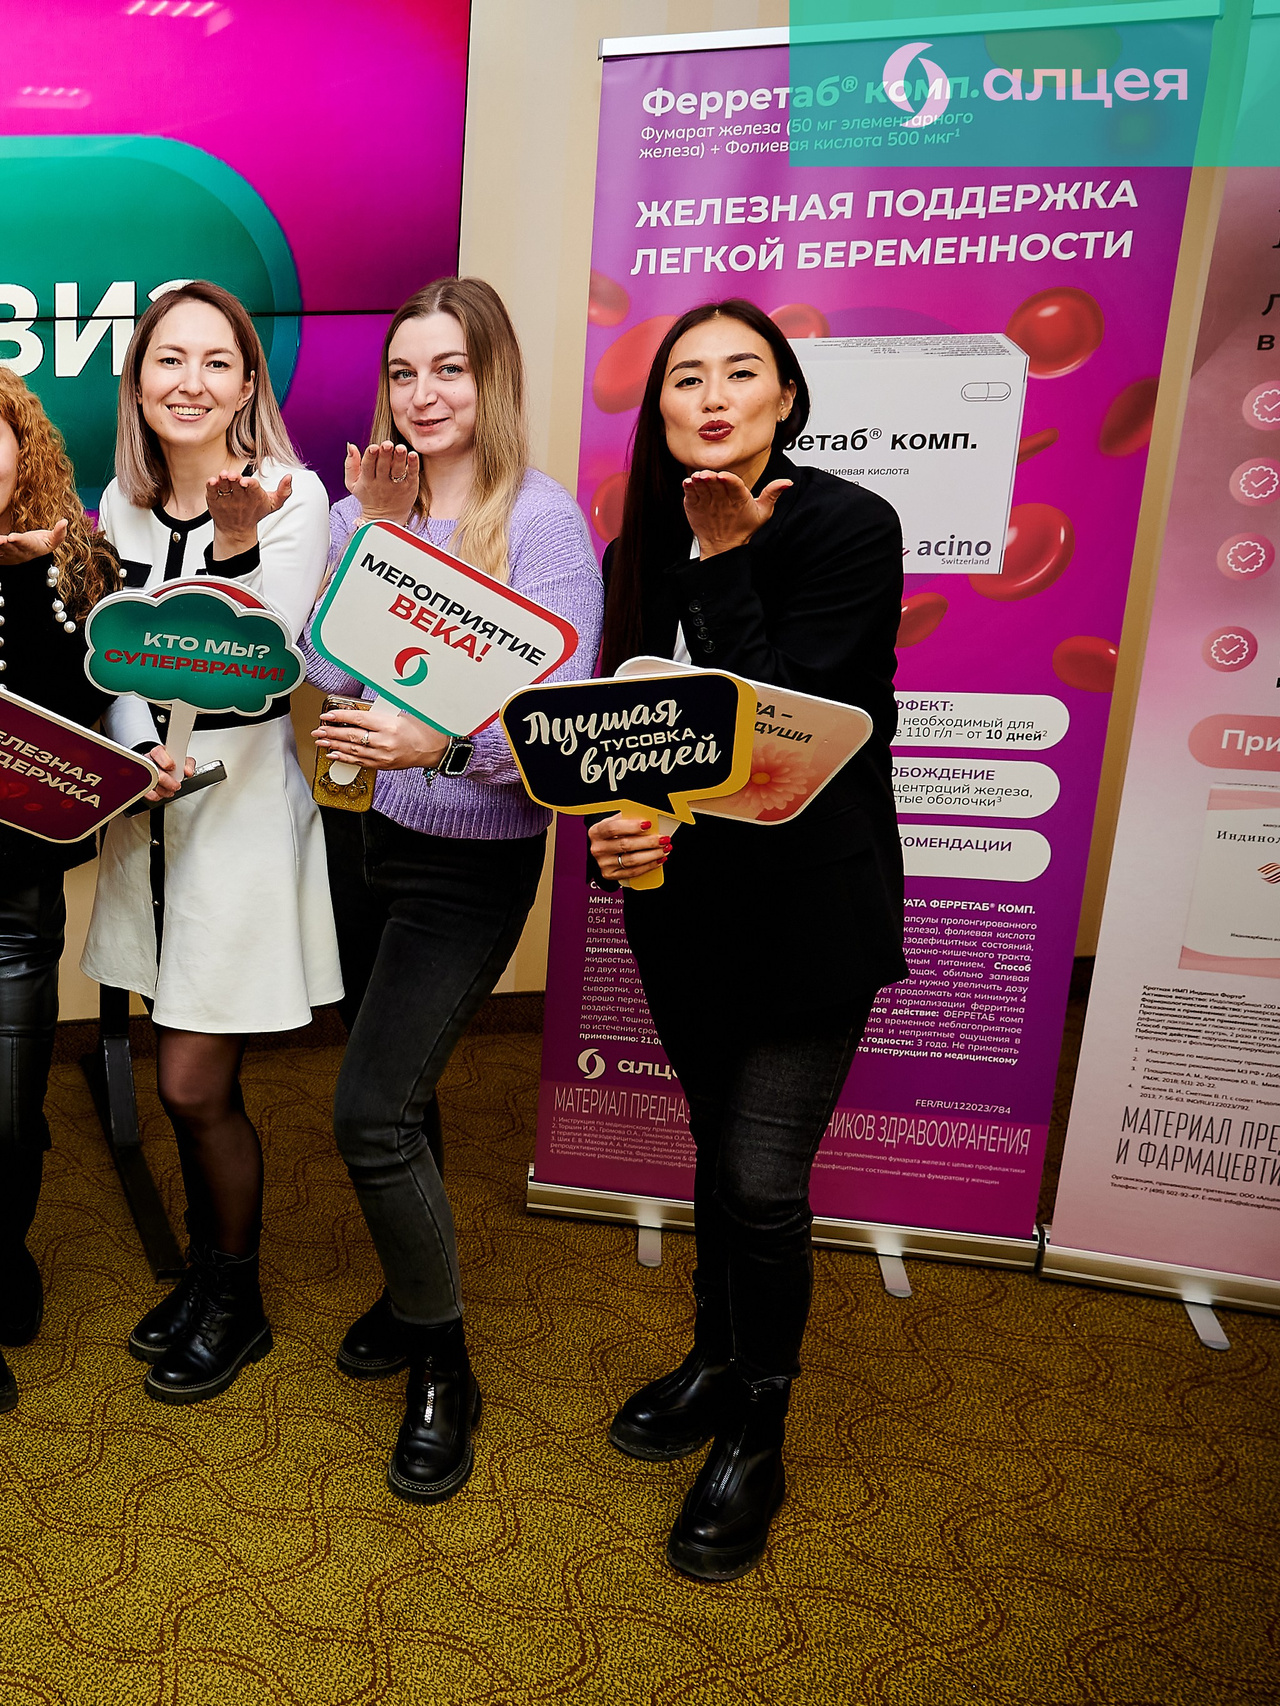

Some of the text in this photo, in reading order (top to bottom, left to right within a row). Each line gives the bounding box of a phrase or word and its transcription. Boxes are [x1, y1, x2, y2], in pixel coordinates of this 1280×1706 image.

[866, 75, 980, 104] комп.
[641, 112, 973, 141] Фумарат железа (50 мг элементарного
[638, 144, 705, 159] железа)
[711, 145, 719, 154] +
[725, 140, 809, 154] Фолиевая
[814, 136, 882, 150] кислота
[888, 132, 918, 146] 500
[636, 179, 1138, 227] ЖЕЛЕЗНАЯ ПОДДЕРЖКА
[630, 230, 1133, 276] ЛЕГКОЙ БЕРЕМЕННОСТИ
[891, 432, 977, 450] комп.
[868, 467, 909, 475] кислота
[917, 534, 992, 556] acino
[360, 553, 546, 666] МЕРОПРИЯТИЕ
[388, 594, 492, 663] ВЕКА!
[144, 632, 271, 659] КТО МЫ?
[104, 649, 286, 682] СУПЕРВРАЧИ!
[522, 699, 682, 755] Лучшая
[903, 715, 1034, 729] необходимый для
[600, 728, 696, 752] ТУСОВКА
[907, 727, 930, 737] 110
[934, 728, 952, 738] г/л
[967, 731, 982, 739] от
[986, 730, 1002, 739] 10
[1221, 729, 1280, 756] При
[580, 734, 721, 791] врачей
[892, 767, 995, 780] ОБОЖДЕНИЕ
[893, 783, 1033, 798] центраций железа,
[900, 837, 1012, 852] ОМЕНДАЦИИ
[589, 896, 613, 904] МНН:
[588, 907, 623, 915] действи
[998, 904, 1036, 914] КОМП.
[904, 916, 1037, 930] апсулы пролонгированного
[945, 928, 992, 938] фолиевая
[996, 932, 1036, 940] кислота
[597, 966, 617, 974] двух
[994, 961, 1031, 972] Способ
[584, 975, 614, 983] недели
[943, 969, 983, 979] обильно
[989, 974, 1029, 982] запивая
[920, 979, 949, 987] нужно
[953, 981, 1002, 991] увеличить
[1005, 985, 1028, 994] дозу
[582, 994, 614, 1003] хорошо
[895, 989, 952, 998] продолжать
[974, 993, 1018, 1003] минимум
[582, 1004, 635, 1013] воздействие
[896, 999, 965, 1009] нормализации
[971, 1001, 1025, 1013] ферритина
[622, 1016, 654, 1025] тошнот
[892, 1008, 939, 1018] действие:
[943, 1010, 995, 1022] ФЕРРЕТАБ
[592, 1024, 636, 1033] истечении
[885, 1018, 935, 1027] временное
[938, 1020, 1022, 1034] неблагоприятное
[579, 1033, 638, 1043] применению:
[899, 1029, 955, 1039] неприятные
[959, 1033, 1010, 1043] ощущения
[867, 1036, 914, 1046] годности:
[968, 1043, 1019, 1055] применять
[871, 1046, 928, 1058] инструкции
[945, 1052, 1018, 1066] медицинскому
[618, 1059, 678, 1080] алц
[554, 1086, 627, 1117] МАТЕРИАЛ
[915, 1099, 1011, 1115] FER/RU/122023/784
[823, 1111, 1031, 1155] НИКОВ ЗДРАВООХРАНЕНИЯ
[1121, 1106, 1280, 1155] МАТЕРИАЛ ПРЕ
[1116, 1138, 1280, 1187] И ФАРМАЦЕВТИ
